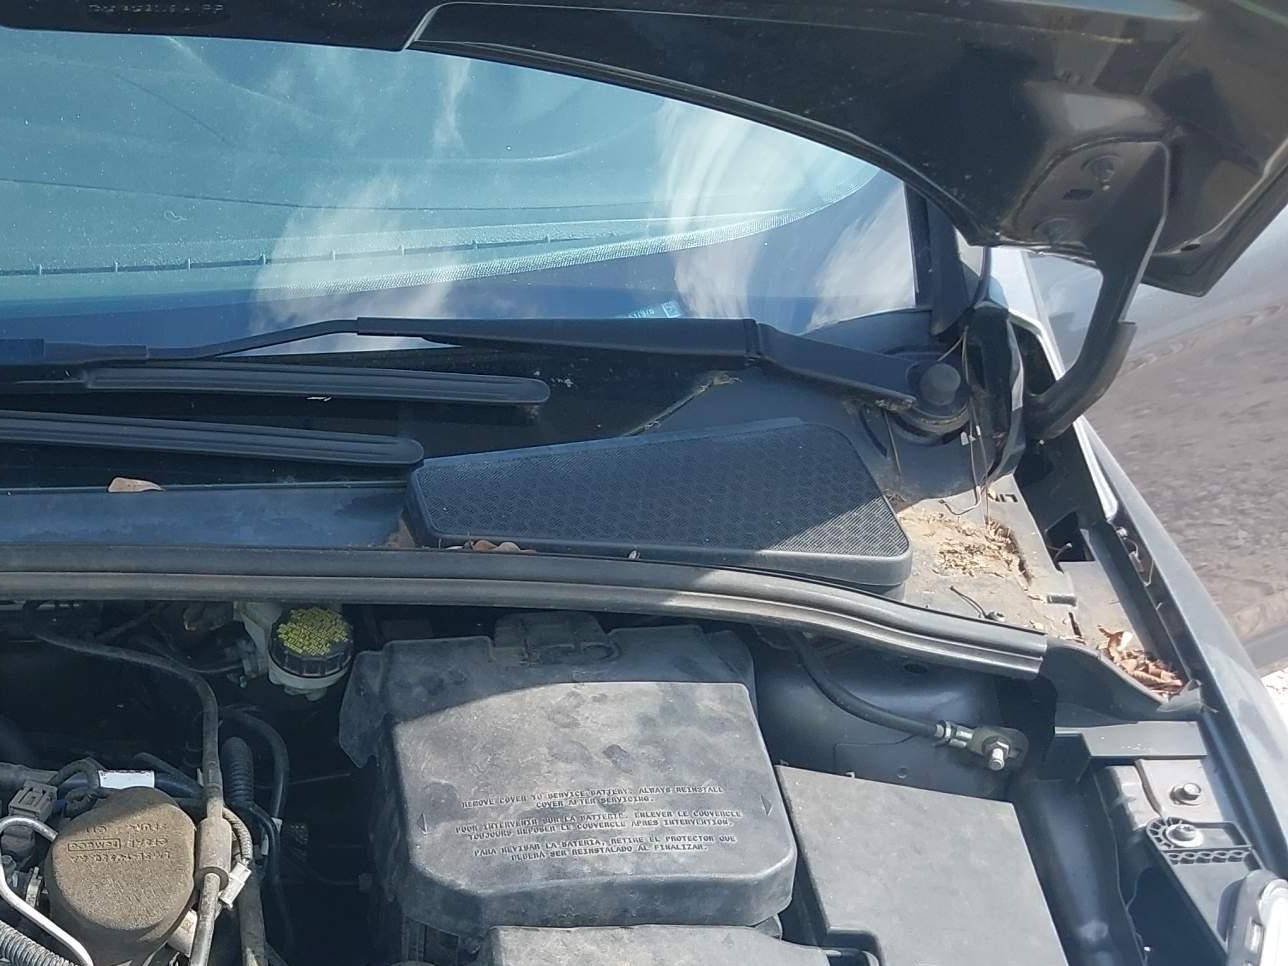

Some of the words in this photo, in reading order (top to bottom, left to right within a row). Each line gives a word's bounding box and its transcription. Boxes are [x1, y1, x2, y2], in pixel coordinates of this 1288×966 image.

[461, 799, 494, 809] REMOVE
[499, 795, 527, 804] COVER
[548, 789, 585, 799] SERVICE
[639, 786, 671, 794] ALWAYS
[676, 785, 724, 793] REINSTALL
[536, 800, 564, 809] COVER
[568, 797, 598, 806] AFTER
[469, 829, 512, 840] TOUJOURS
[517, 825, 556, 836] REPOSER
[576, 821, 626, 830] COUVERCLE
[483, 819, 538, 831] INTERVENIR
[474, 848, 497, 857] PARA
[501, 843, 541, 853] REVISAR
[608, 837, 644, 845] RETIRE
[719, 834, 737, 842] QUE
[549, 849, 568, 857] SER
[572, 845, 633, 856] REINSTALADO
